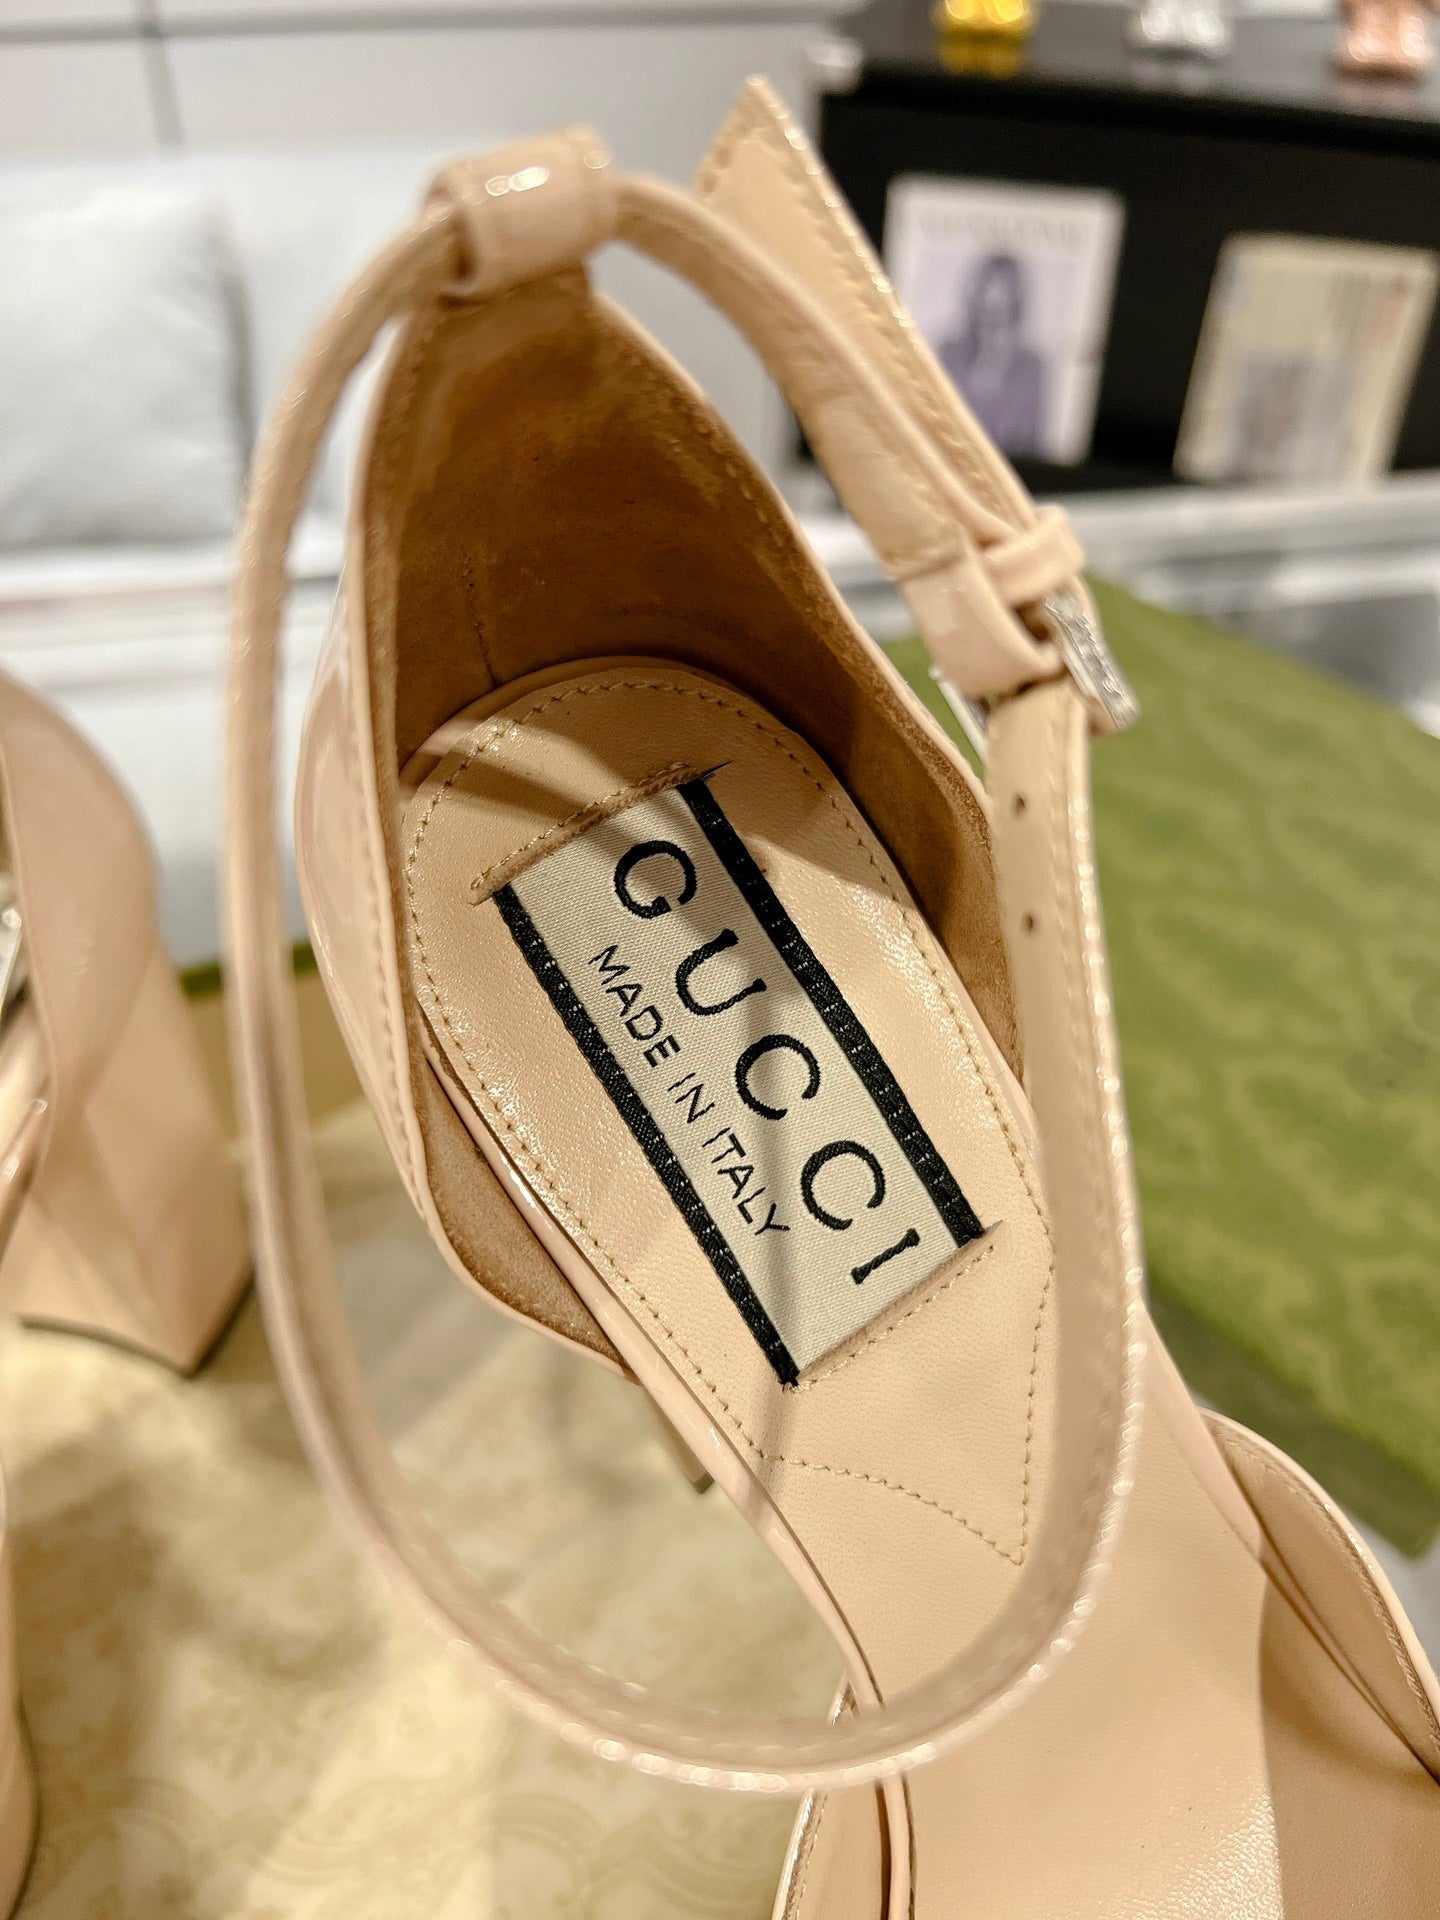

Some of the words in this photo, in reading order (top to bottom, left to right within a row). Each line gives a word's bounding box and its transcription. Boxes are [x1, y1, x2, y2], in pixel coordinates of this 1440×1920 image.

[589, 945, 681, 1068] MADE
[668, 1072, 716, 1124] IN
[703, 1128, 790, 1237] ITALY
[614, 840, 921, 1285] GUCCI
